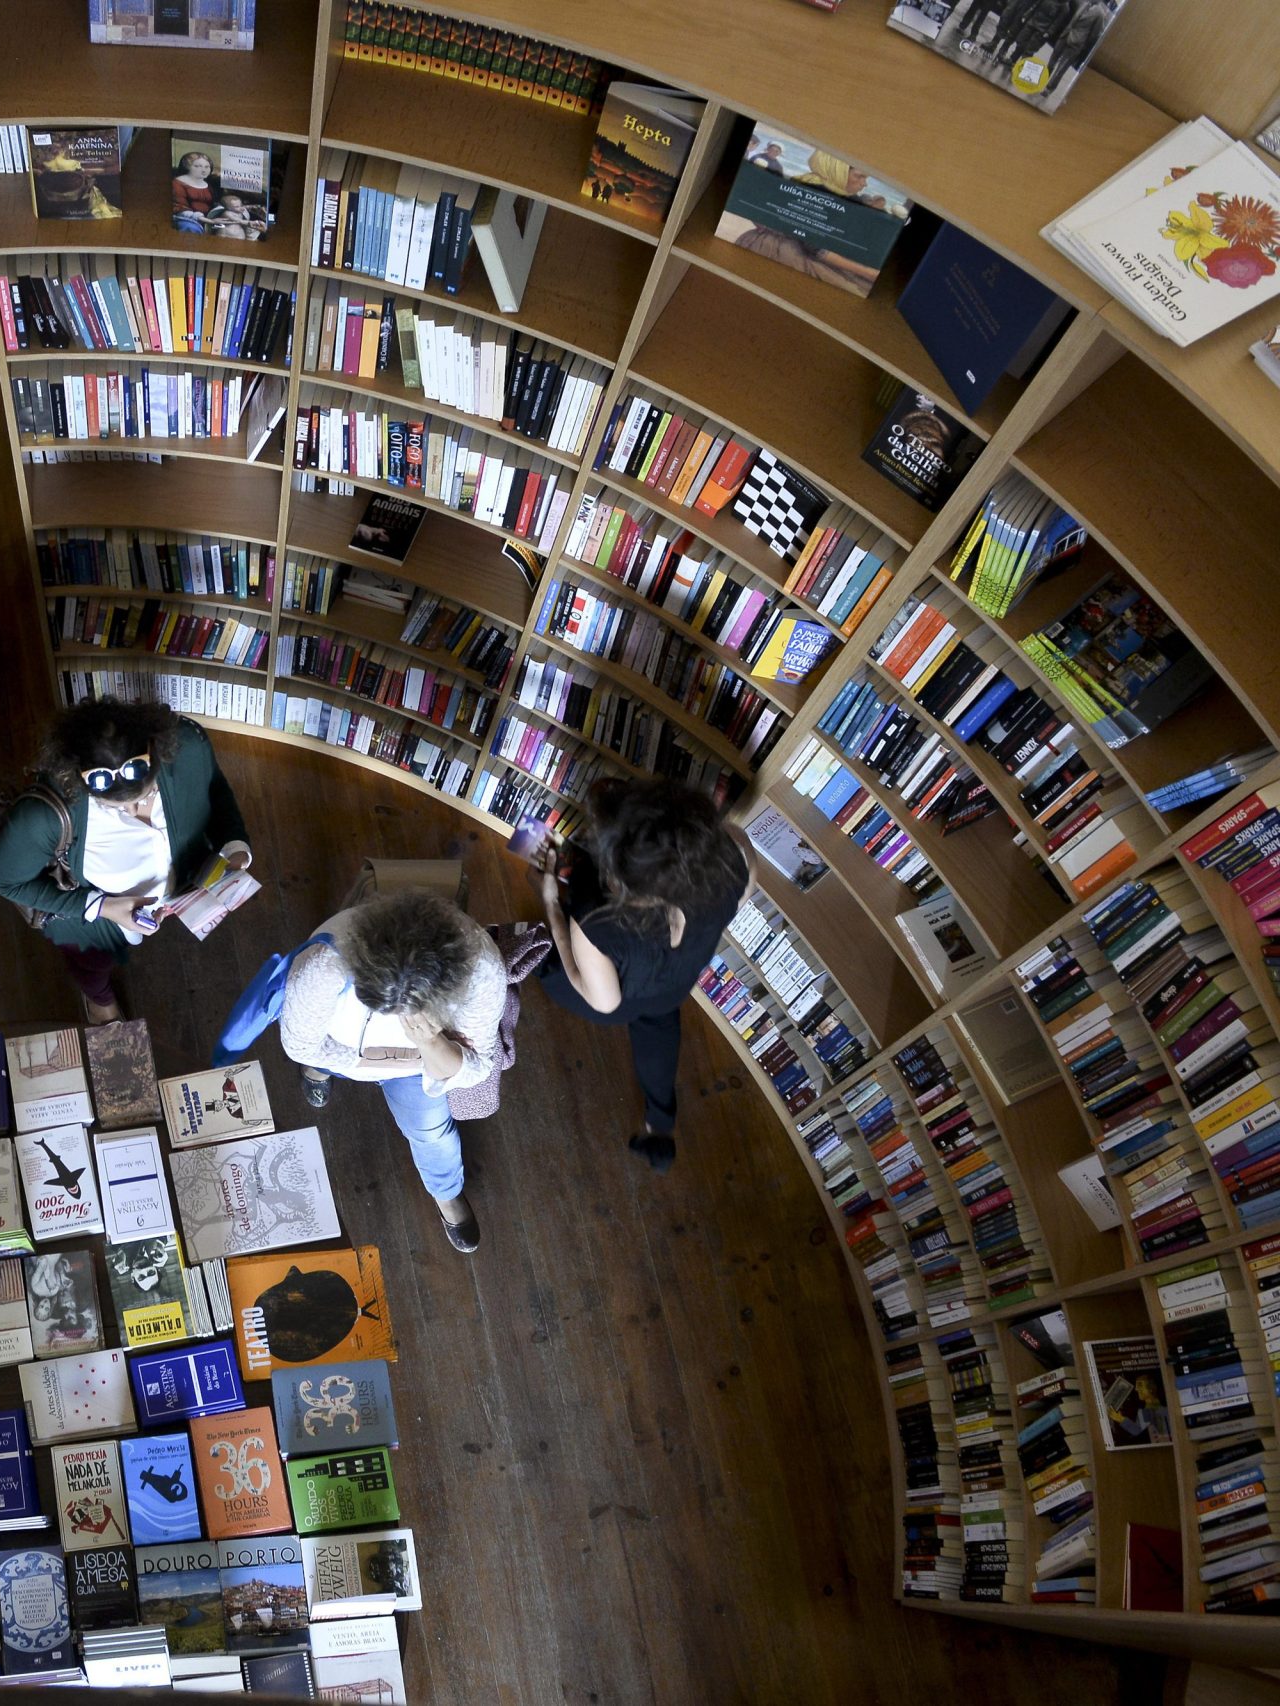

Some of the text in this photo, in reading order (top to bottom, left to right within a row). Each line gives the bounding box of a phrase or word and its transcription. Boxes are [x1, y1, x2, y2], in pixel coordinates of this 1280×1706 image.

[623, 114, 671, 146] Hepta
[69, 142, 113, 150] KARENINA
[223, 170, 261, 179] ROSTOS
[323, 193, 338, 228] RADICAL
[780, 183, 846, 213] LUÍSA DACOSTA
[793, 229, 806, 237] ASA
[1101, 242, 1186, 321] Garden Flower
[1134, 252, 1182, 298] Designs
[390, 433, 403, 459] OITO
[409, 433, 421, 460] FOGO
[888, 436, 939, 476] da Velha
[892, 424, 951, 473] O Tango
[891, 448, 939, 489] Guarda
[372, 499, 421, 518] ANIMAIS
[1014, 737, 1039, 763] LENNOX
[1218, 809, 1247, 833] SPARKS
[1235, 819, 1264, 843] SPARKS
[929, 913, 952, 926] NOA NOA
[35, 1194, 64, 1210] 2000
[220, 1180, 234, 1218] árvores
[230, 1163, 250, 1231] de domingo
[39, 1202, 91, 1221] Tubarão
[128, 1317, 182, 1336] D'ALMEIDA
[241, 1306, 271, 1370] TEATRO
[210, 1365, 218, 1380] Brasil
[47, 1396, 56, 1416] Artes
[299, 1375, 360, 1436] 36
[357, 1380, 374, 1426] HOURS
[63, 1449, 107, 1462] PEDRO MEXIA
[65, 1460, 106, 1480] NADA DE
[210, 1437, 271, 1500] 36
[68, 1479, 111, 1491] MELANCOLIA
[224, 1496, 268, 1512] HOURS
[307, 1480, 320, 1525] MUNDO
[320, 1498, 330, 1524] DOS
[328, 1489, 339, 1523] VIVOS
[346, 1486, 357, 1520] MEXIA
[305, 1516, 313, 1526] O
[74, 1552, 127, 1570] LISBOA
[144, 1554, 212, 1572] DOURO
[226, 1546, 296, 1566] PORTO
[87, 1567, 128, 1584] MESA
[328, 1546, 347, 1598] ZWEIG
[76, 1586, 96, 1595] GUIA
